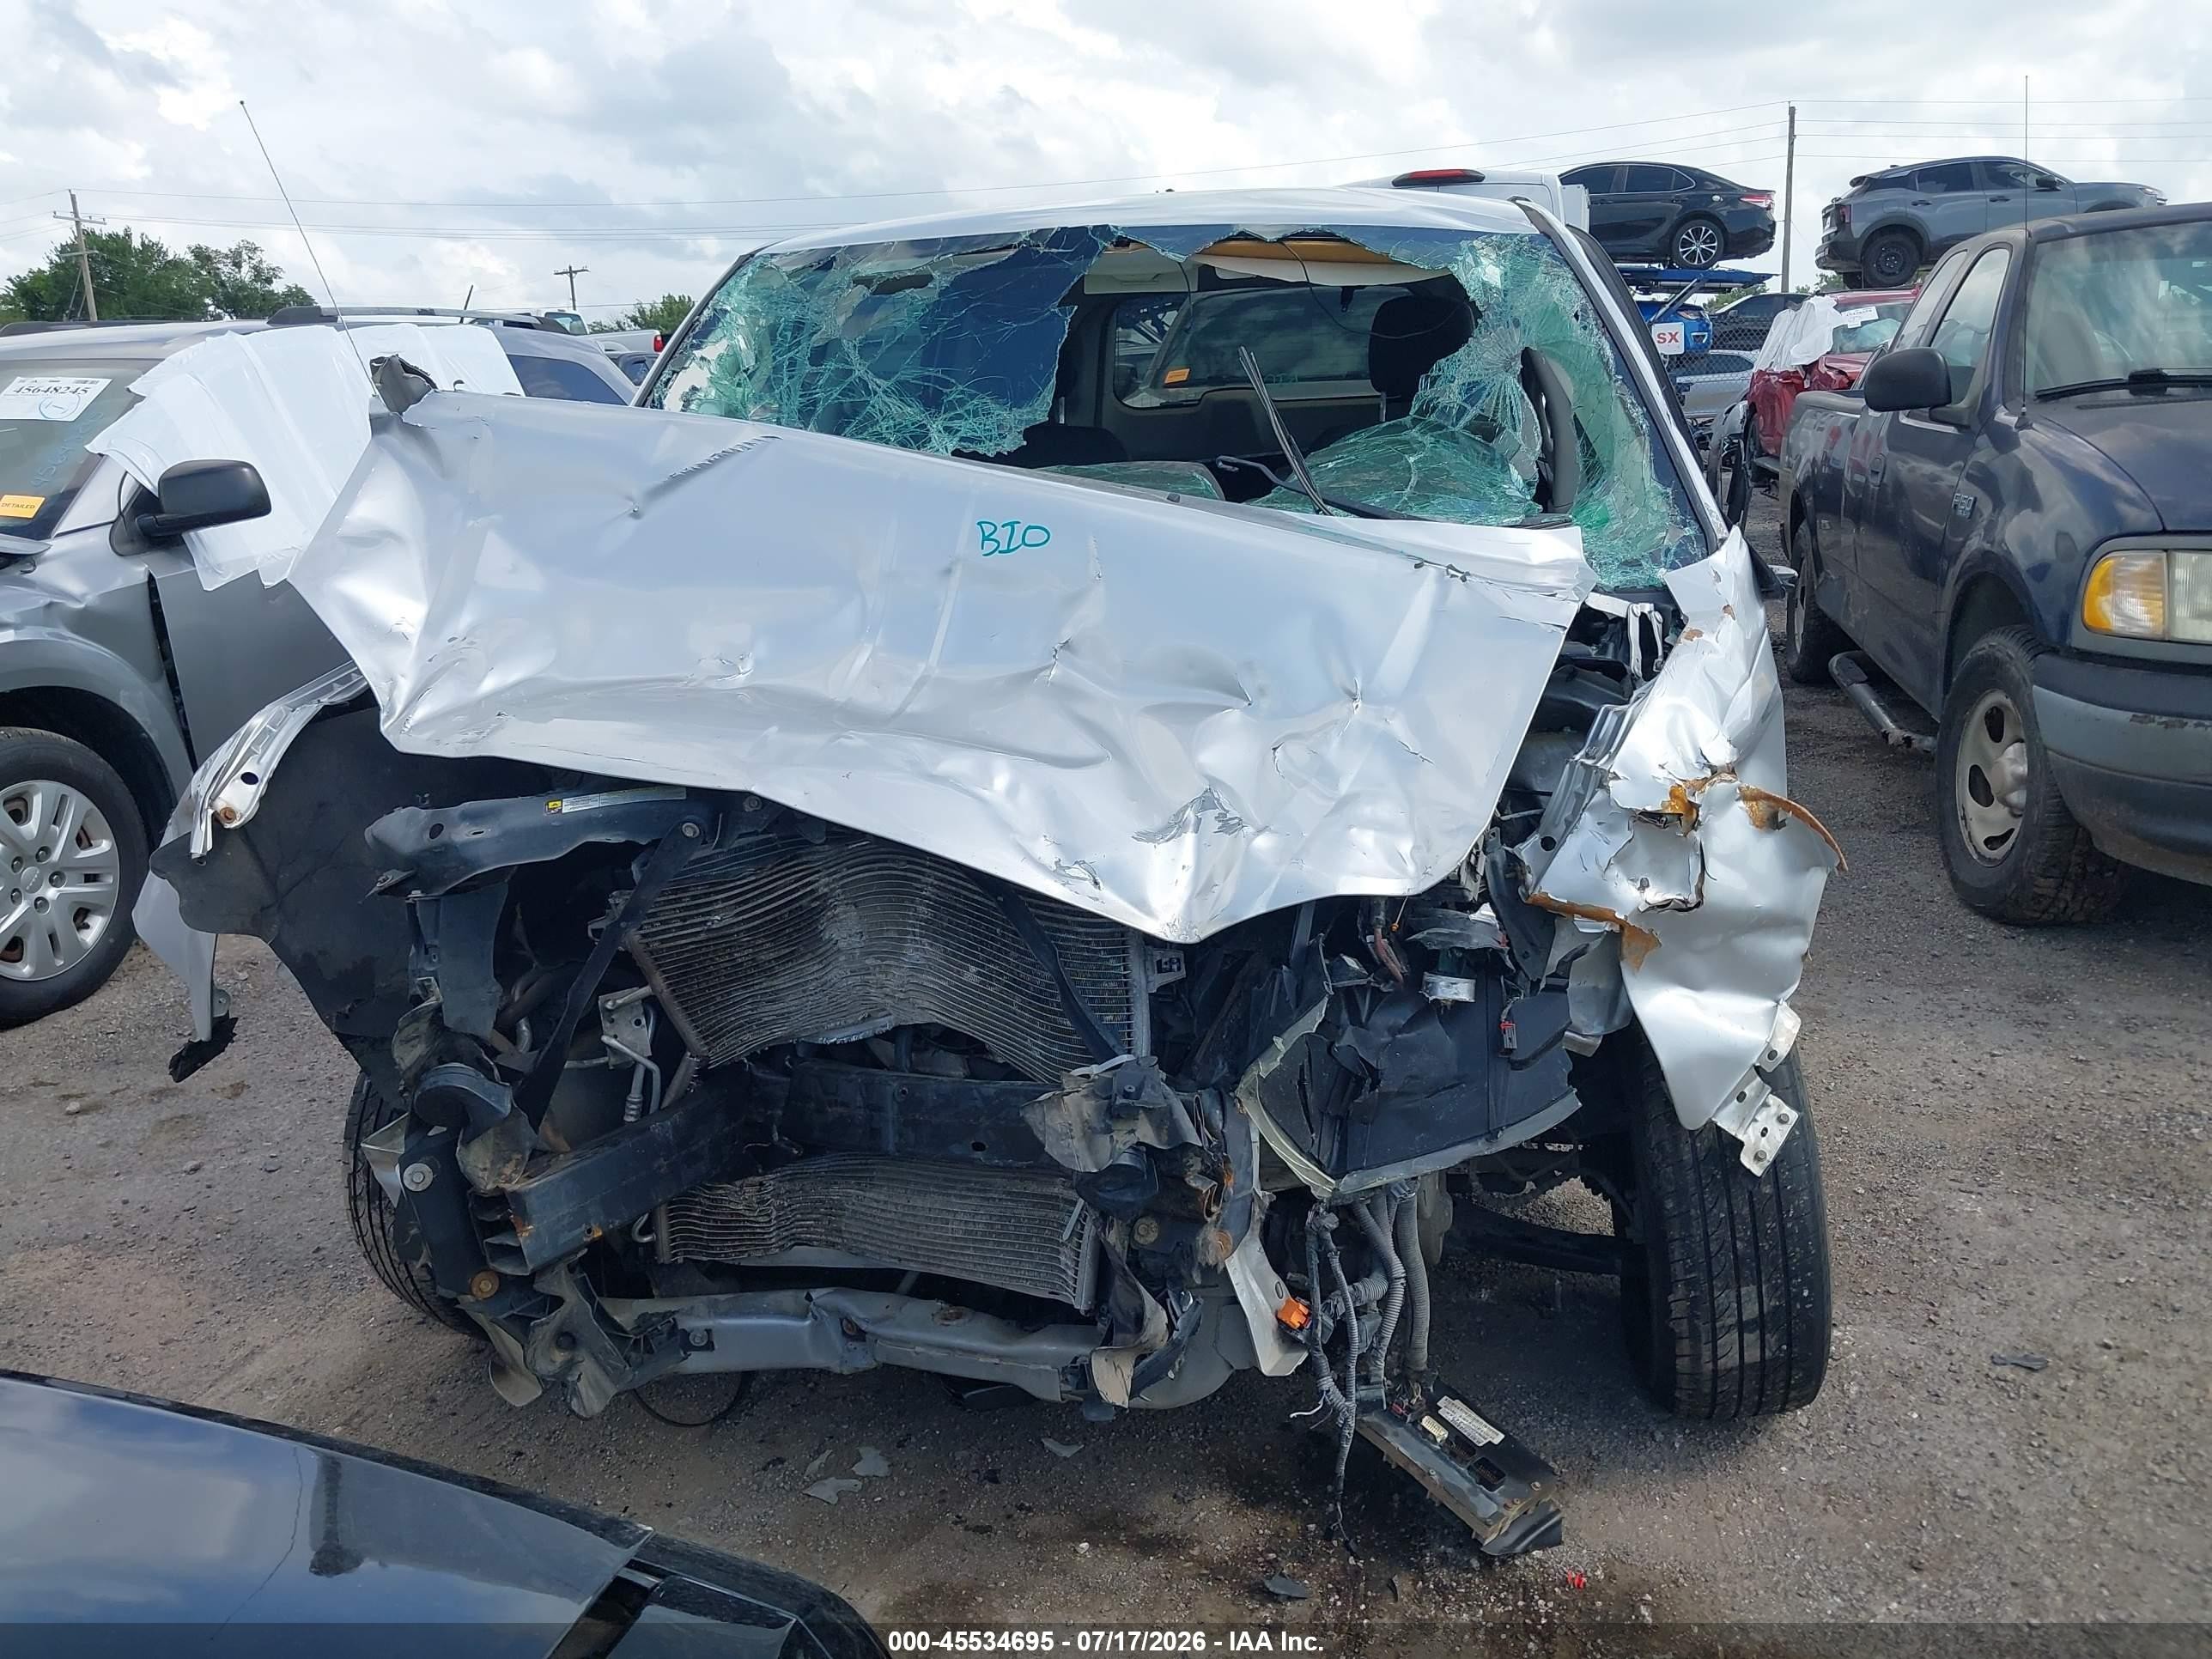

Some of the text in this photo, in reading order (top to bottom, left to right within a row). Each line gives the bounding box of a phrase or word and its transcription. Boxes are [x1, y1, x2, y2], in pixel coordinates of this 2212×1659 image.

[1656, 331, 1679, 344] SX
[13, 386, 91, 395] 45648245
[976, 520, 1051, 556] BIO
